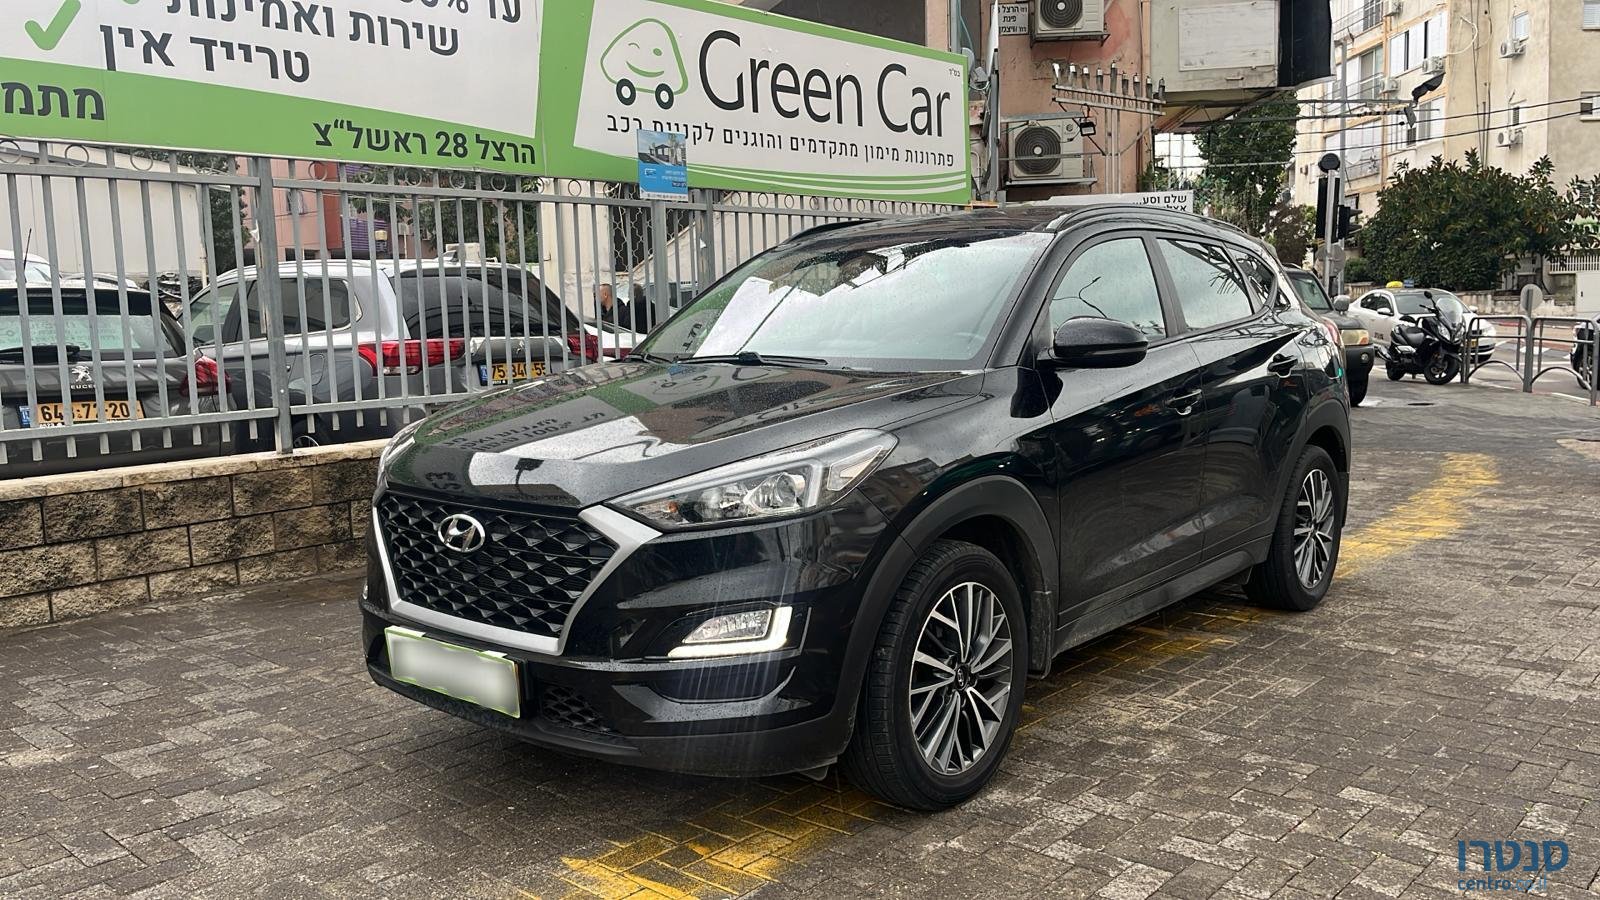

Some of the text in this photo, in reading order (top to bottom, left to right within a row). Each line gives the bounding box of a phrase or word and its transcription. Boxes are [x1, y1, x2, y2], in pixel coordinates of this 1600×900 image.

[349, 11, 458, 56] שירות
[100, 25, 310, 83] טרייד אין
[699, 30, 950, 137] Green Car
[607, 114, 642, 133] רכב
[435, 131, 468, 158] 28
[475, 133, 536, 164] הרצל
[723, 128, 782, 149] והוגנים
[790, 136, 858, 159] מתקדמים
[864, 145, 900, 163] מימון
[905, 149, 954, 167] פתרונות
[1164, 194, 1187, 204] שלם
